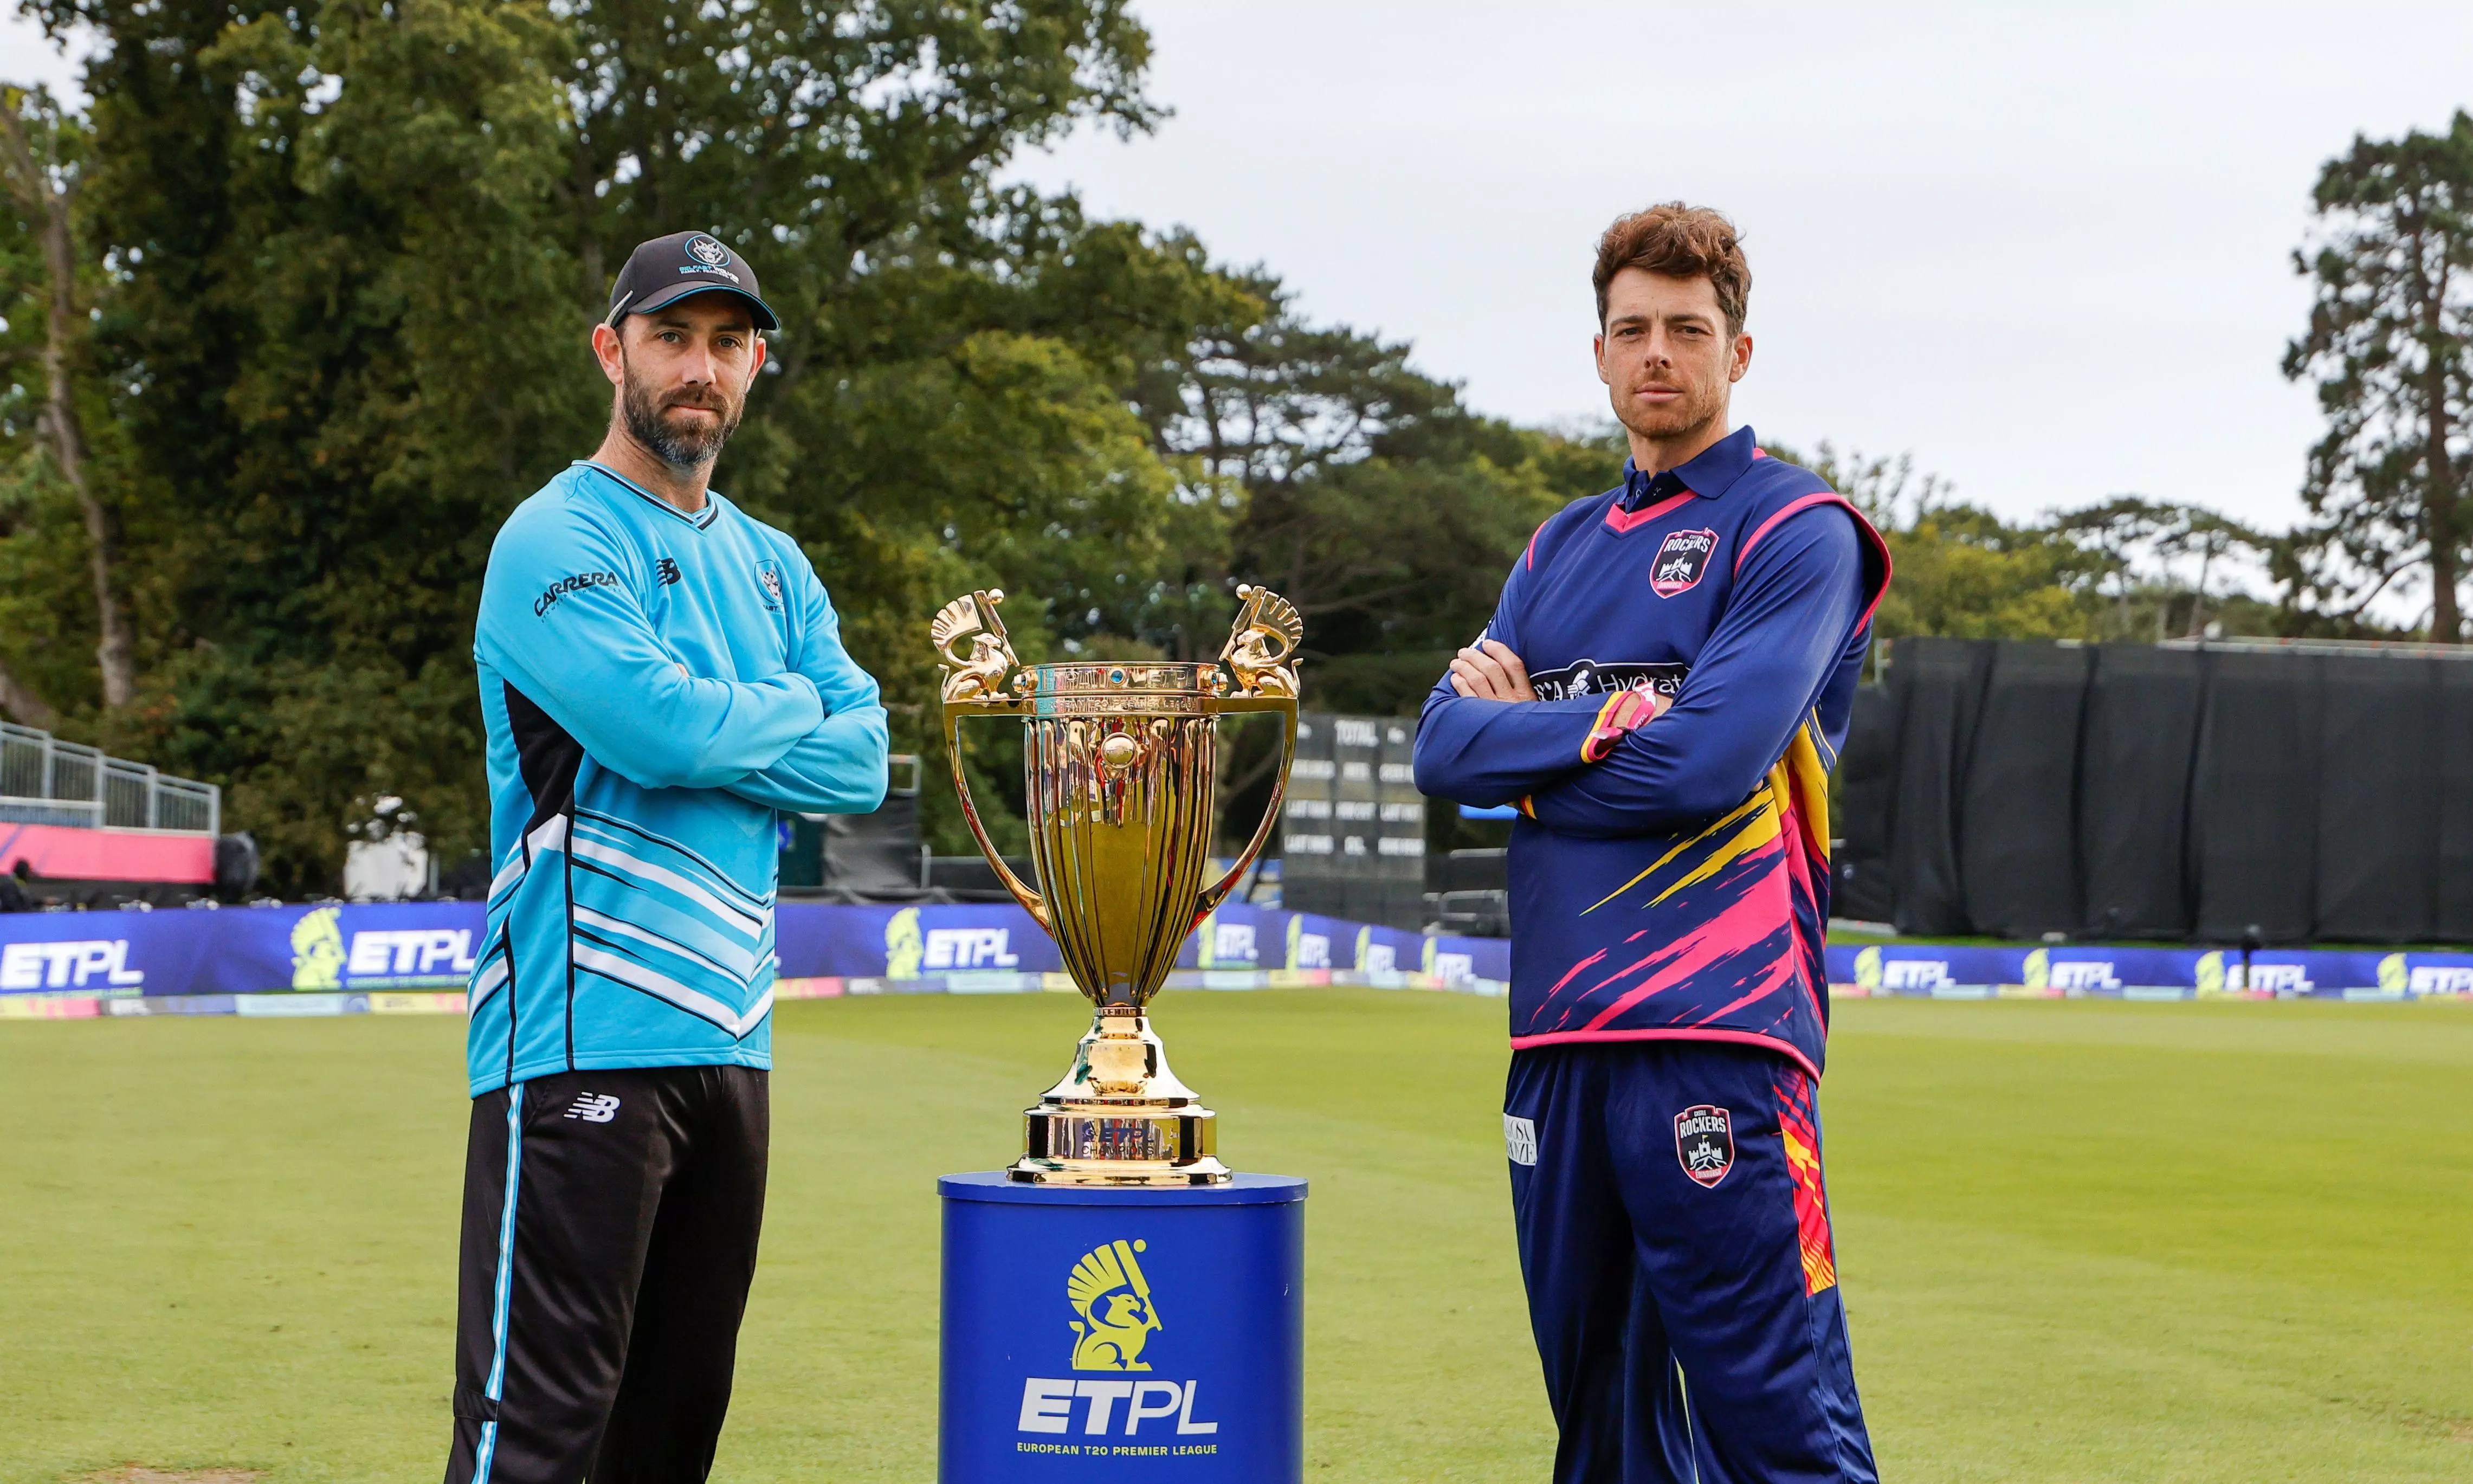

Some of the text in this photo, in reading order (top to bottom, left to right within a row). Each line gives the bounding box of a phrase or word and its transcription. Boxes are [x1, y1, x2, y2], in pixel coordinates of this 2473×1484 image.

[534, 571, 618, 617] CARRERA
[347, 928, 475, 974] ETPL
[922, 927, 1019, 967] ETPL
[0, 939, 145, 989] ETPL
[1882, 959, 1957, 990] ETPL
[2049, 961, 2123, 990] ETPL
[2409, 966, 2473, 993] ETP
[1679, 1116, 1727, 1139] ROCKERS
[1081, 1145, 1154, 1156] CHAMPIONS
[1017, 1377, 1218, 1436] ETPL
[1017, 1442, 1217, 1456] EUROPEAN T20 PREMIER LEAGUE
